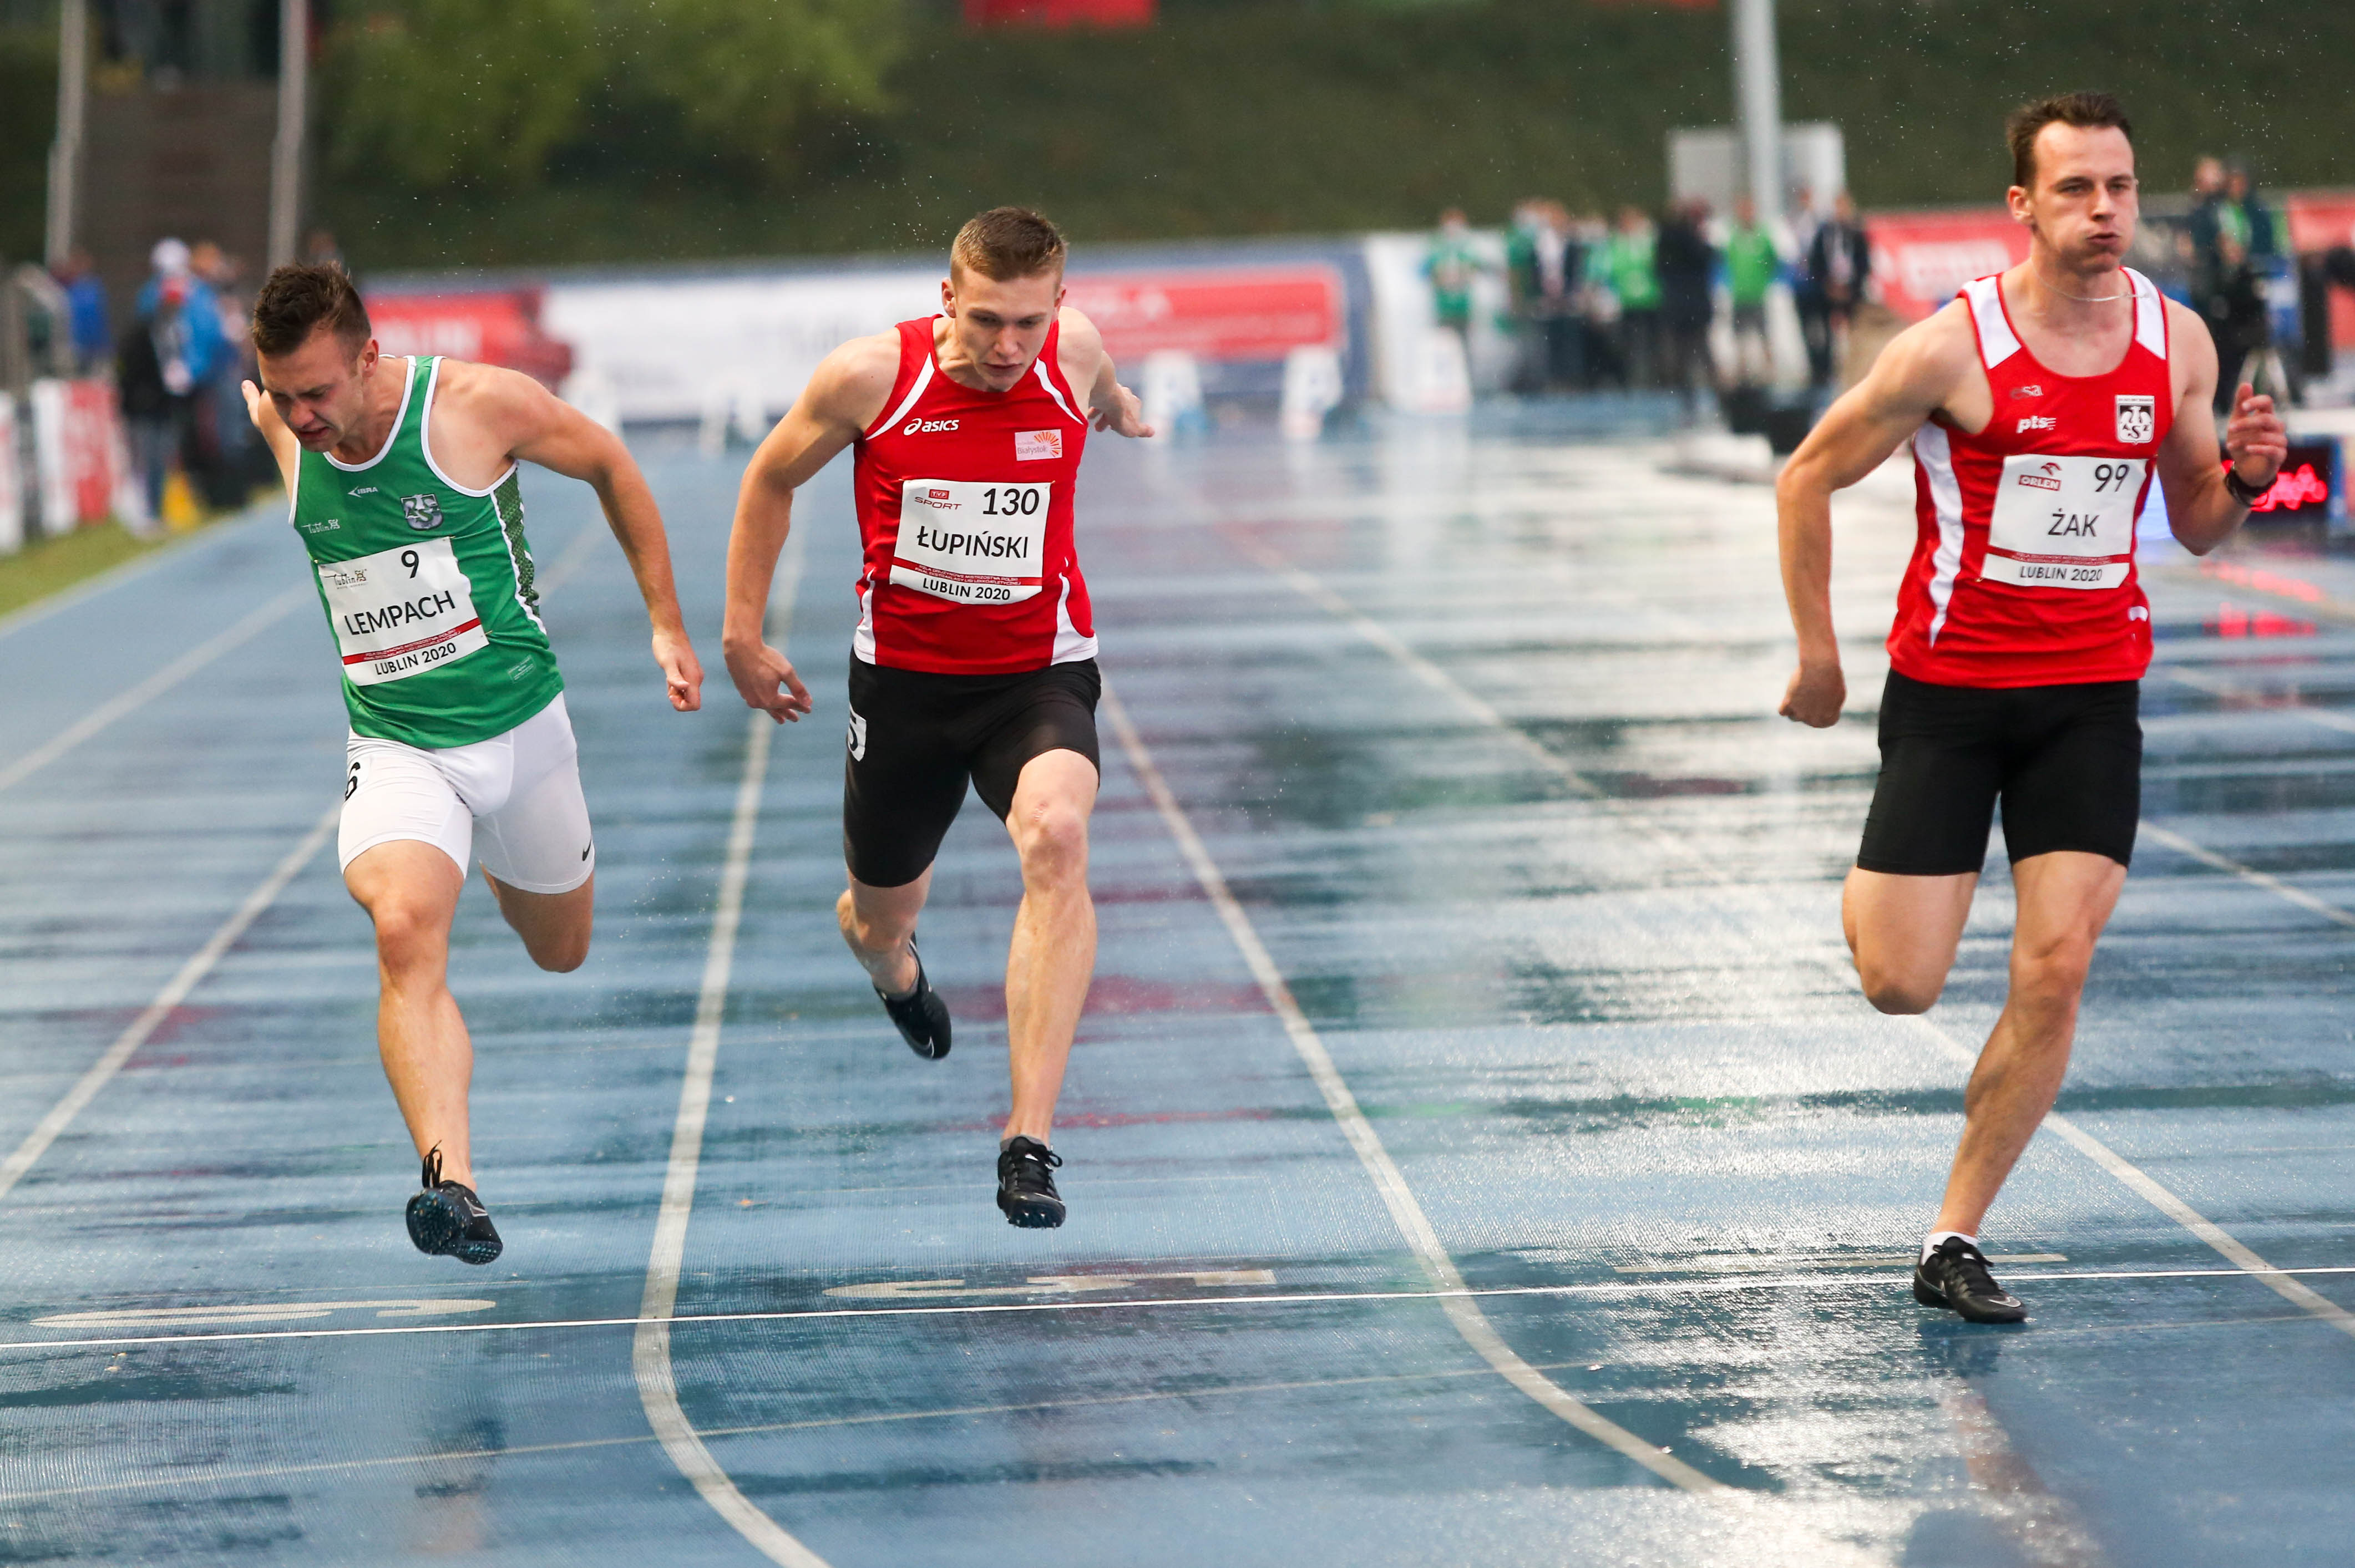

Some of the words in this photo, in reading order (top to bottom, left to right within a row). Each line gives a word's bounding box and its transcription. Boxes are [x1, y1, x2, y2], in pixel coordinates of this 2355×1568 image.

[921, 419, 959, 432] asics
[2020, 476, 2059, 490] ORLEN
[2095, 464, 2130, 492] 99
[915, 496, 962, 510] SPORT
[983, 488, 1039, 516] 130
[2048, 508, 2100, 537] ŻAK
[917, 526, 1028, 559] ŁUPIŃSKI
[401, 550, 419, 578] 9
[2020, 566, 2067, 580] LUBLIN
[2071, 569, 2103, 582] 2020
[923, 578, 971, 597] LUBLIN
[975, 587, 1010, 600] 2020
[344, 591, 455, 635] LEMPACH
[374, 654, 418, 675] LUBLIN
[422, 642, 457, 663] 2020
